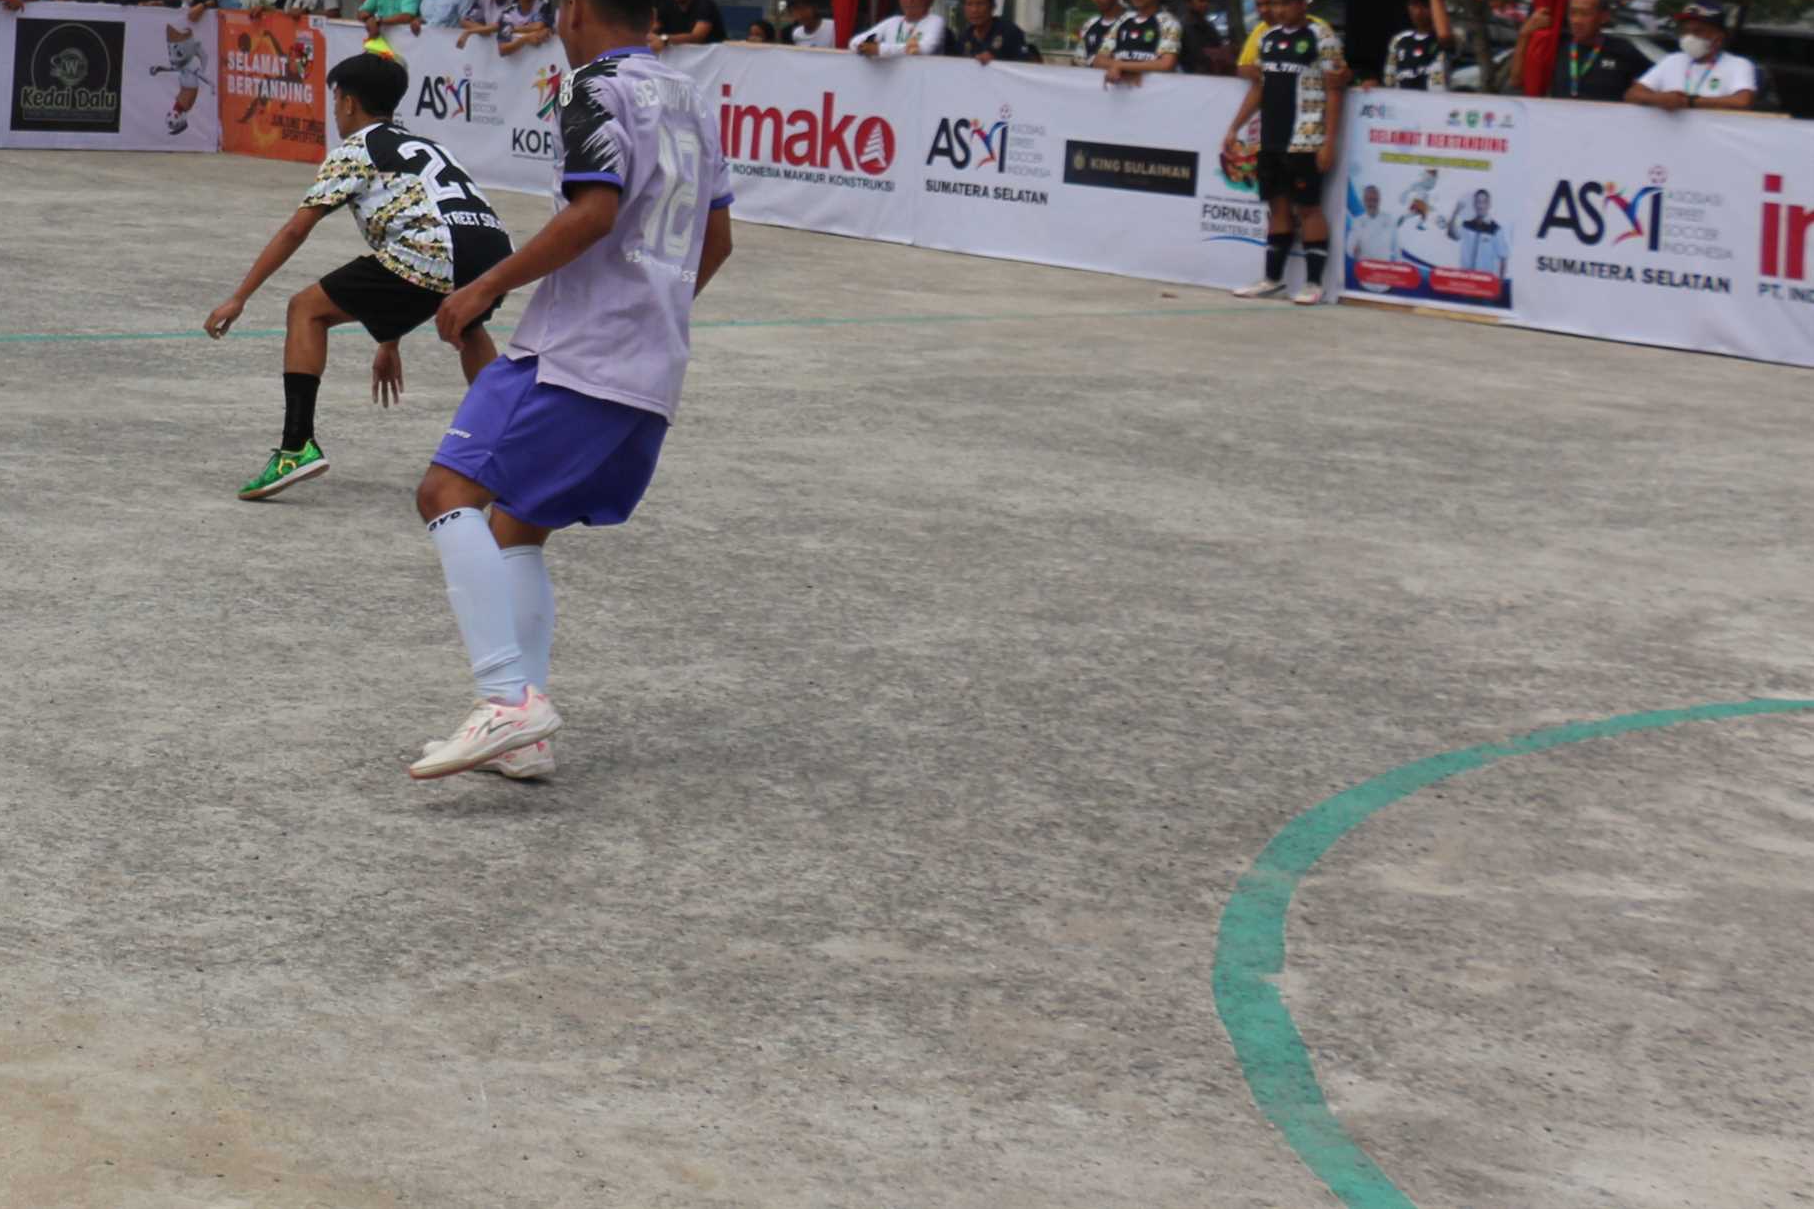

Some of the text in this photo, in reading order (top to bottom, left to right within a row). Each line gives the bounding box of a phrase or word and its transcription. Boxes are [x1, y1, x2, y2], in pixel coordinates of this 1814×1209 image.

[227, 51, 288, 78] SELAMAT
[21, 86, 117, 110] Kedai Dalu
[227, 76, 313, 103] BERTANDING
[720, 84, 896, 176] imako
[784, 169, 827, 184] MAKMUR
[829, 175, 896, 192] KONSTRUKSI
[1090, 158, 1191, 180] KING SULAIMAN
[925, 178, 1048, 205] SUMATERA SELATAN
[1202, 203, 1261, 225] FORNAS
[1536, 255, 1732, 294] SUMATERA SELATAN
